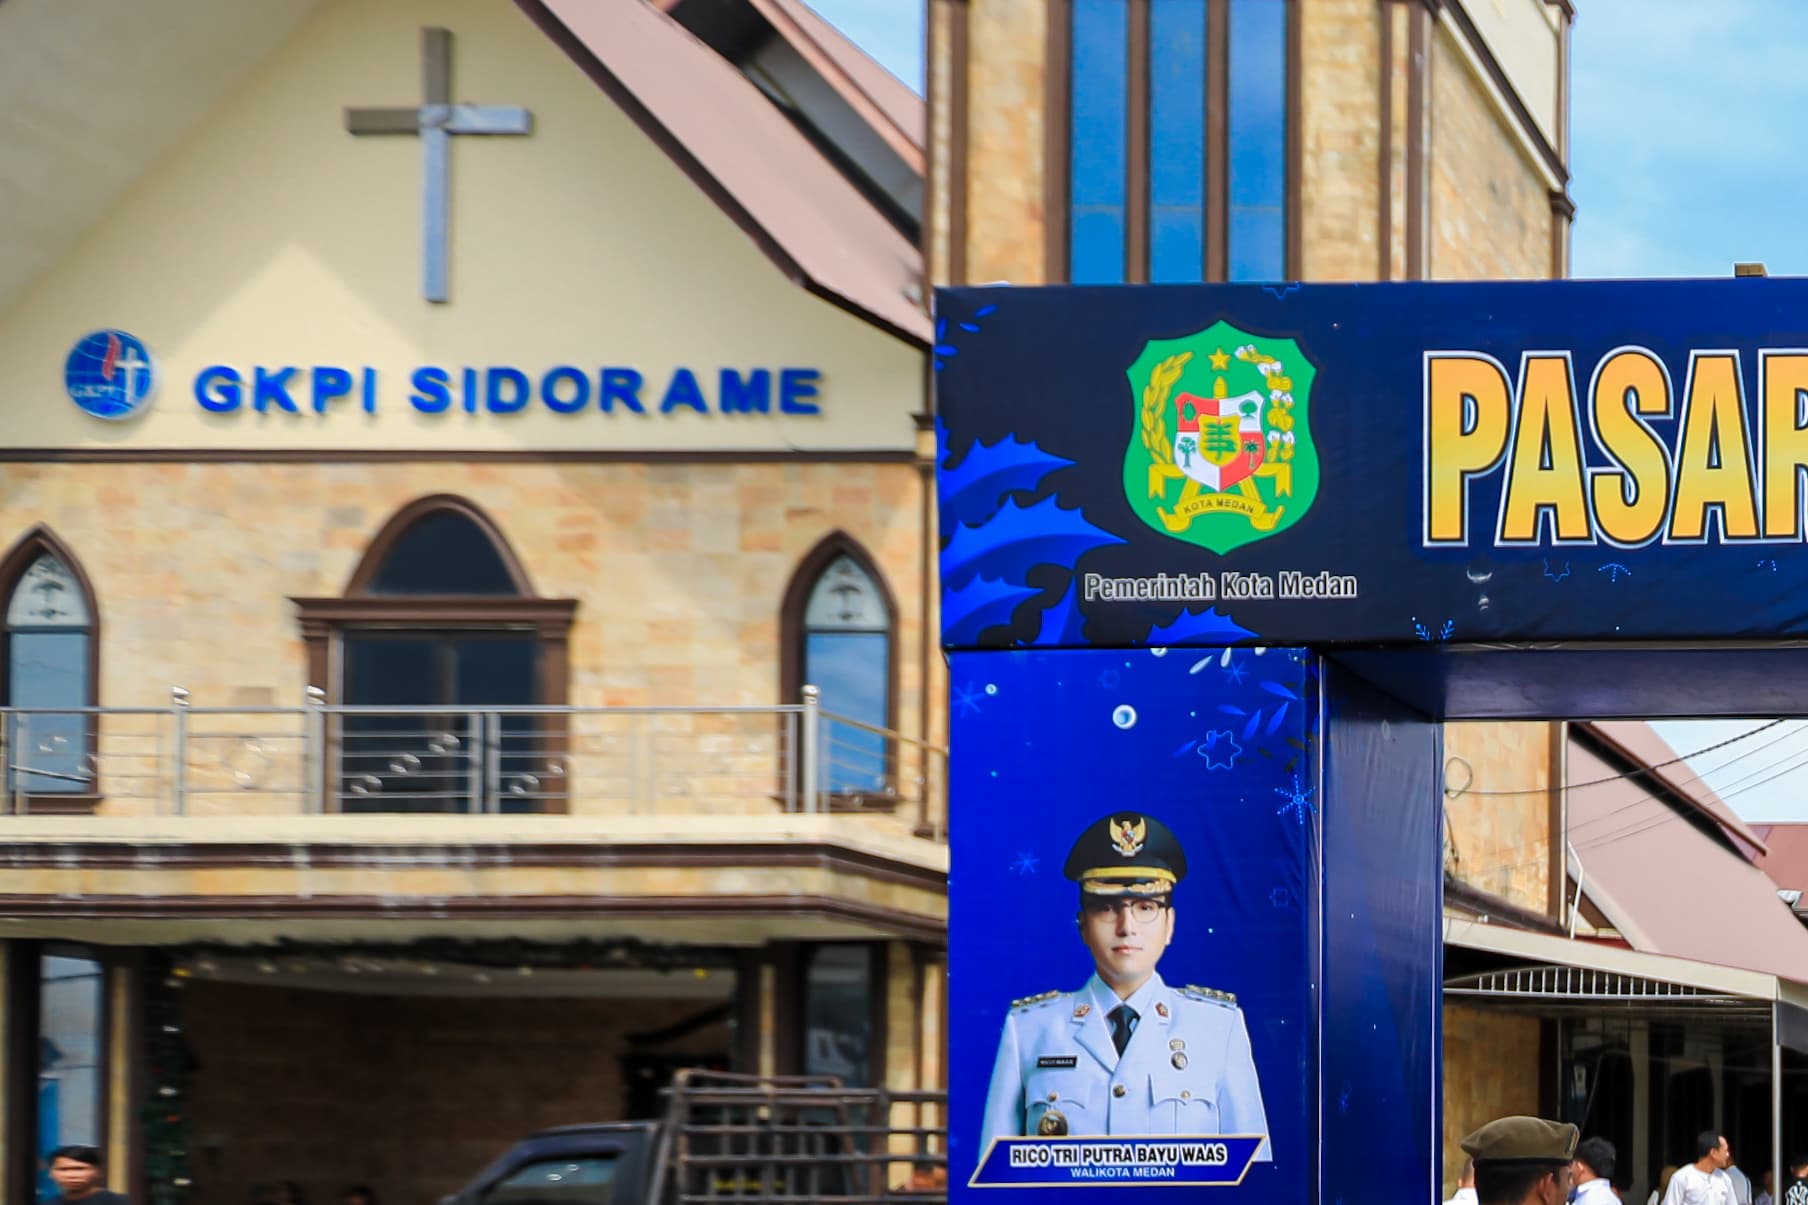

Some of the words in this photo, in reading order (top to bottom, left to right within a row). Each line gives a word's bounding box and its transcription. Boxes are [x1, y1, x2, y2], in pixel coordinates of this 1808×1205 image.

[194, 365, 377, 415] GKPI
[409, 365, 822, 416] SIDORAME
[1183, 499, 1213, 514] KOTA
[1216, 498, 1255, 514] MEDAN
[1084, 573, 1215, 601] Pemerintah
[1221, 572, 1273, 599] Kota
[1279, 571, 1357, 599] Medan
[1010, 1145, 1049, 1166] RICO
[1053, 1145, 1078, 1165] TRI
[1081, 1144, 1134, 1164] PUTRA
[1137, 1144, 1178, 1164] BAYU
[1180, 1143, 1226, 1164] WAAS
[1071, 1167, 1130, 1178] WALIKOTA
[1133, 1167, 1175, 1177] MEDAN
